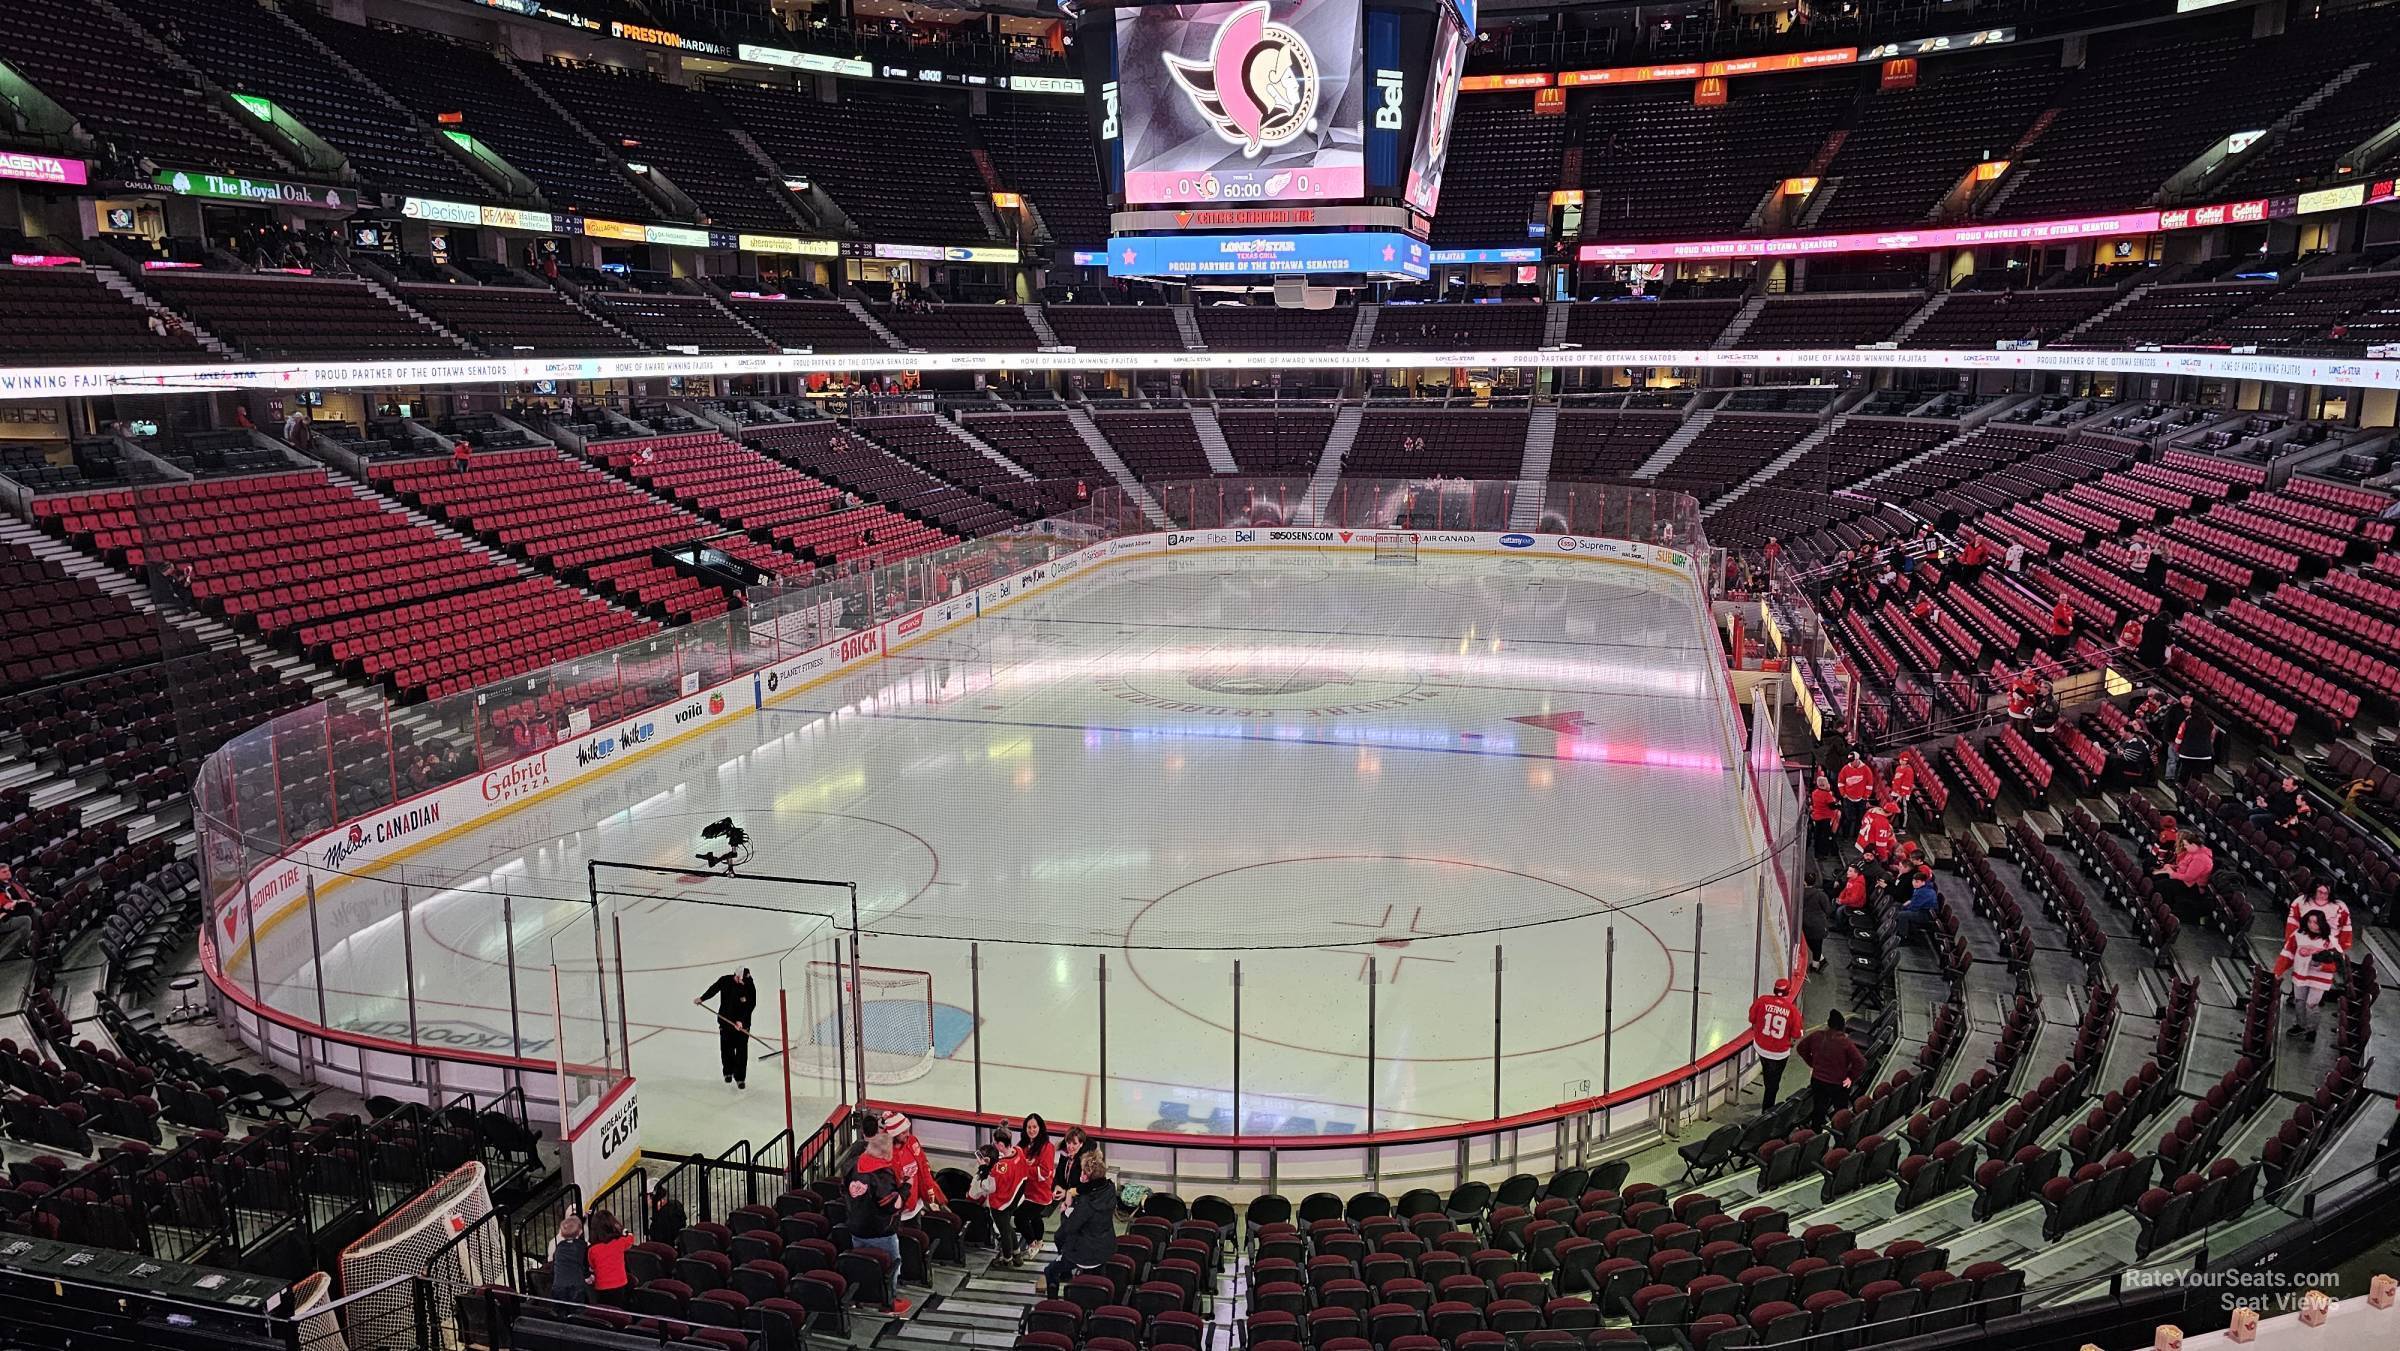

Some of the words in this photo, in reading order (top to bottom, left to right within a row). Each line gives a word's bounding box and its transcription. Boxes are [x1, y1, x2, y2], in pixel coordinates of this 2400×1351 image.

[623, 24, 680, 47] PRESTON
[680, 38, 732, 56] HARDWARE
[1376, 69, 1403, 130] Bell
[1103, 82, 1118, 140] Bell
[0, 155, 64, 173] AGENTA
[153, 183, 173, 192] STAND
[205, 175, 237, 194] The
[239, 178, 283, 201] Royal
[283, 184, 313, 202] Oak
[1179, 180, 1190, 194] 0
[1297, 176, 1309, 192] 0
[1224, 184, 1262, 197] 60:00
[420, 200, 475, 222] Decisive
[483, 206, 518, 225] RE/MAX
[2161, 209, 2188, 226] Gabriel
[2195, 205, 2225, 223] Gabriel
[2232, 200, 2263, 219] Gabriel
[1220, 241, 1253, 253] LONE
[1265, 240, 1295, 252] STAR
[1169, 261, 1197, 272] PROUD
[1199, 261, 1234, 271] PARTNER
[1237, 260, 1248, 271] OF
[1251, 260, 1266, 270] THE
[1270, 260, 1304, 270] OTTAWA
[1307, 259, 1349, 270] SENATORS
[839, 358, 846, 366] OF
[848, 358, 859, 366] THE
[861, 358, 885, 366] OTTAWA
[1798, 354, 1819, 362] HOME
[1822, 354, 1832, 362] OF
[1835, 354, 1861, 362] AWARD
[2037, 356, 2057, 364] PROUD
[2087, 357, 2095, 366] OF
[2097, 357, 2109, 366] THE
[2111, 357, 2132, 367] OTTAWA
[315, 369, 348, 380] PROUD
[353, 368, 393, 379] PARTNER
[397, 367, 407, 378] OF
[412, 367, 427, 378] THE
[432, 366, 464, 377] OTTAWA
[468, 365, 507, 376] SENATORS
[616, 363, 633, 372] HOME
[634, 363, 642, 371] OF
[2, 376, 67, 390] WINNING
[1207, 533, 1227, 543] Fibe
[1235, 530, 1256, 542] Bell
[1439, 535, 1476, 543] CANADA
[1579, 539, 1617, 551] Supreme
[1657, 549, 1688, 568] SUBWAY
[1000, 580, 1011, 598] Bell
[829, 646, 841, 659] The
[841, 630, 877, 663] BRICK
[779, 664, 801, 681] PLANET
[802, 657, 824, 674] FITNESS
[675, 701, 703, 724] voilà
[482, 753, 548, 801] Gabriel
[504, 776, 549, 801] PIZZA
[323, 831, 372, 870] Molson
[377, 801, 441, 843] CANADIAN
[241, 880, 278, 925] CAADIAN
[278, 866, 300, 891] TIRE
[1762, 1012, 1787, 1039] 19
[600, 1108, 623, 1137] RIDEAU
